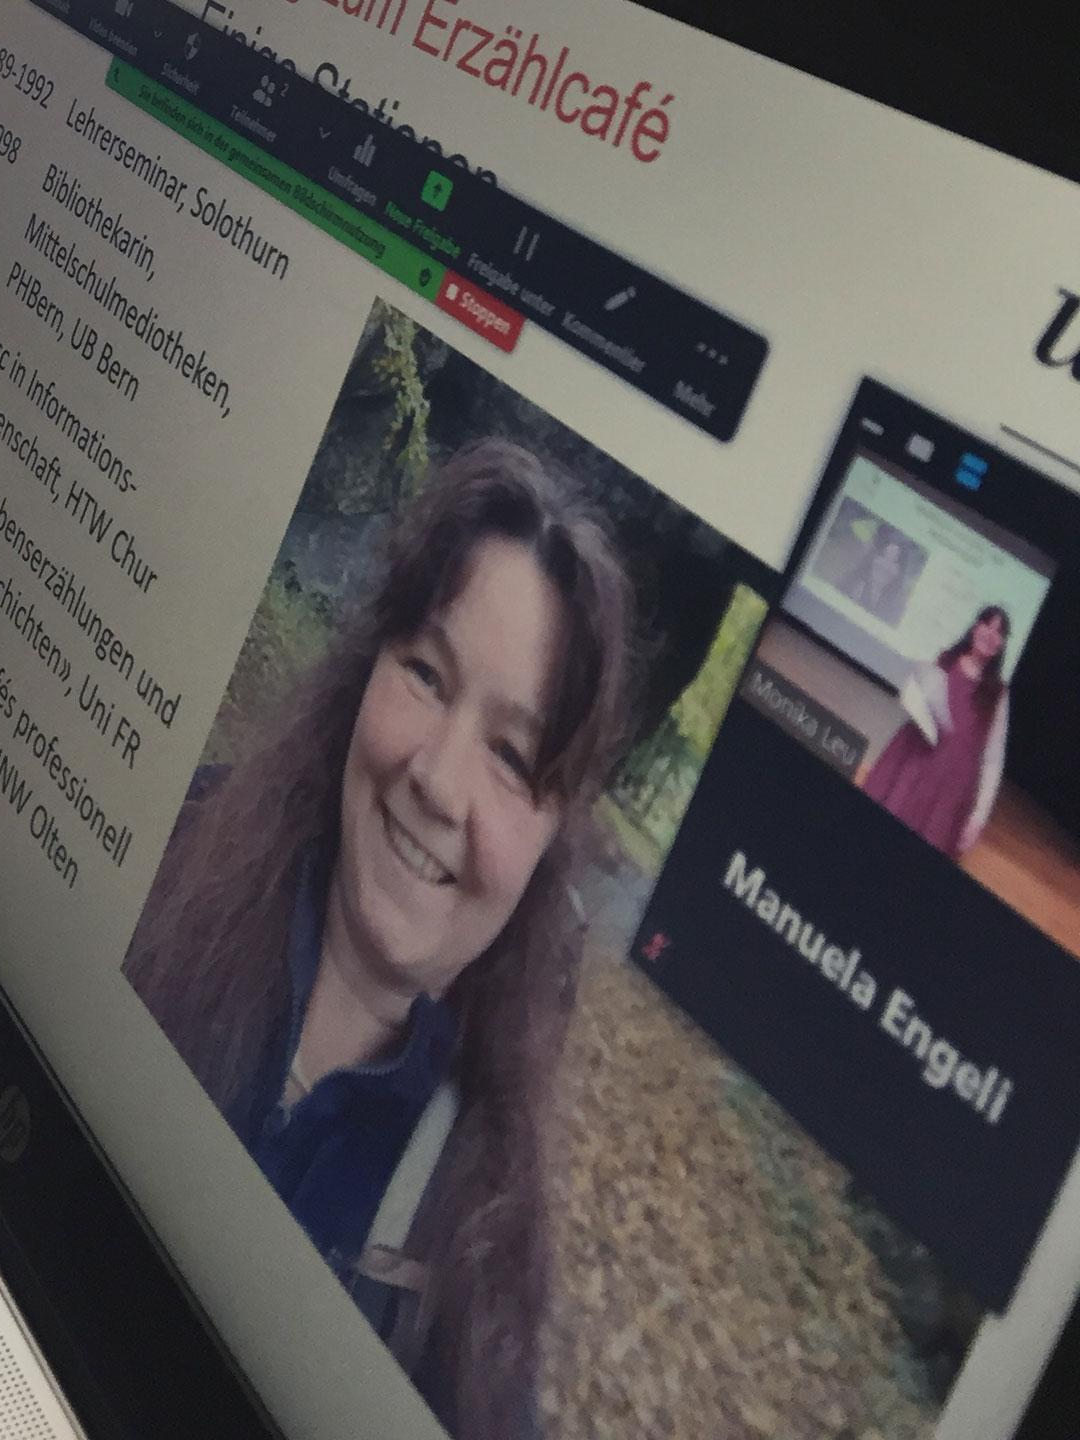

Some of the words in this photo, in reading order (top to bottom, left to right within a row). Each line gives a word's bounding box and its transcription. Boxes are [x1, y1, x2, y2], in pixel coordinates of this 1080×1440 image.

[42, 163, 155, 282] Bibliothekarin,
[66, 98, 188, 213] Lehrerseminar,
[190, 187, 289, 281] Solothurn
[7, 261, 64, 342] PHBern,
[70, 318, 98, 361] UB
[96, 342, 139, 401] Bern
[24, 213, 230, 419] Mittelschulmediotheken,
[459, 291, 512, 335] Stoppen
[9, 352, 26, 388] in
[26, 369, 137, 493] Informations-
[65, 480, 113, 544] HTW
[111, 530, 158, 594] Chur
[79, 674, 116, 736] Uni
[111, 717, 142, 770] FR
[136, 669, 182, 729] und
[13, 709, 133, 868] professionell
[30, 804, 79, 889] Olten
[723, 850, 877, 1011] Manuela
